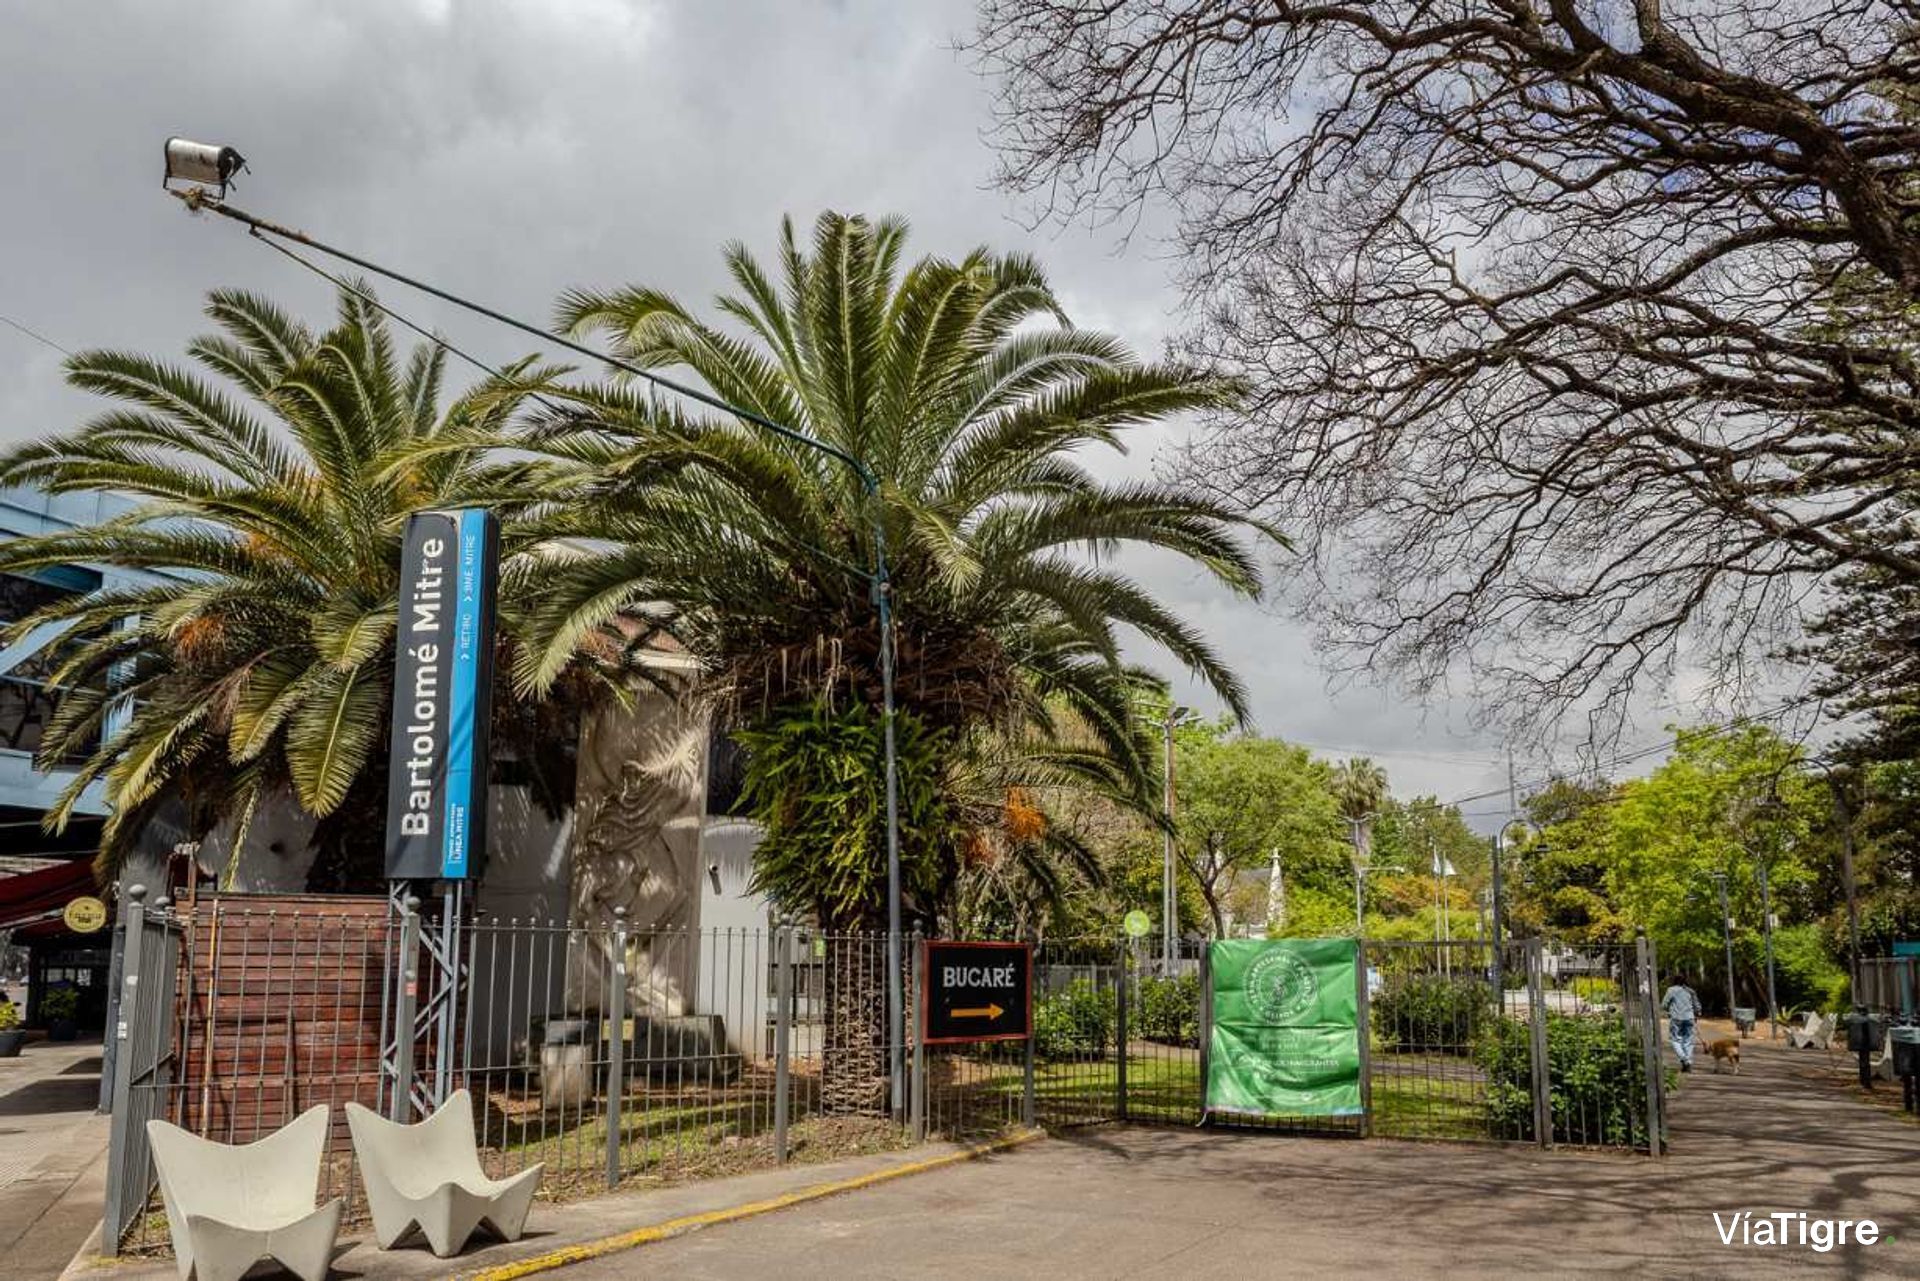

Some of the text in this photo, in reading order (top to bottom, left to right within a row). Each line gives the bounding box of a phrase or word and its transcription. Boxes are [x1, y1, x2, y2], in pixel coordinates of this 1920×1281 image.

[401, 538, 444, 836] Bartolomé Mitre
[943, 962, 1016, 988] BUCARÉ
